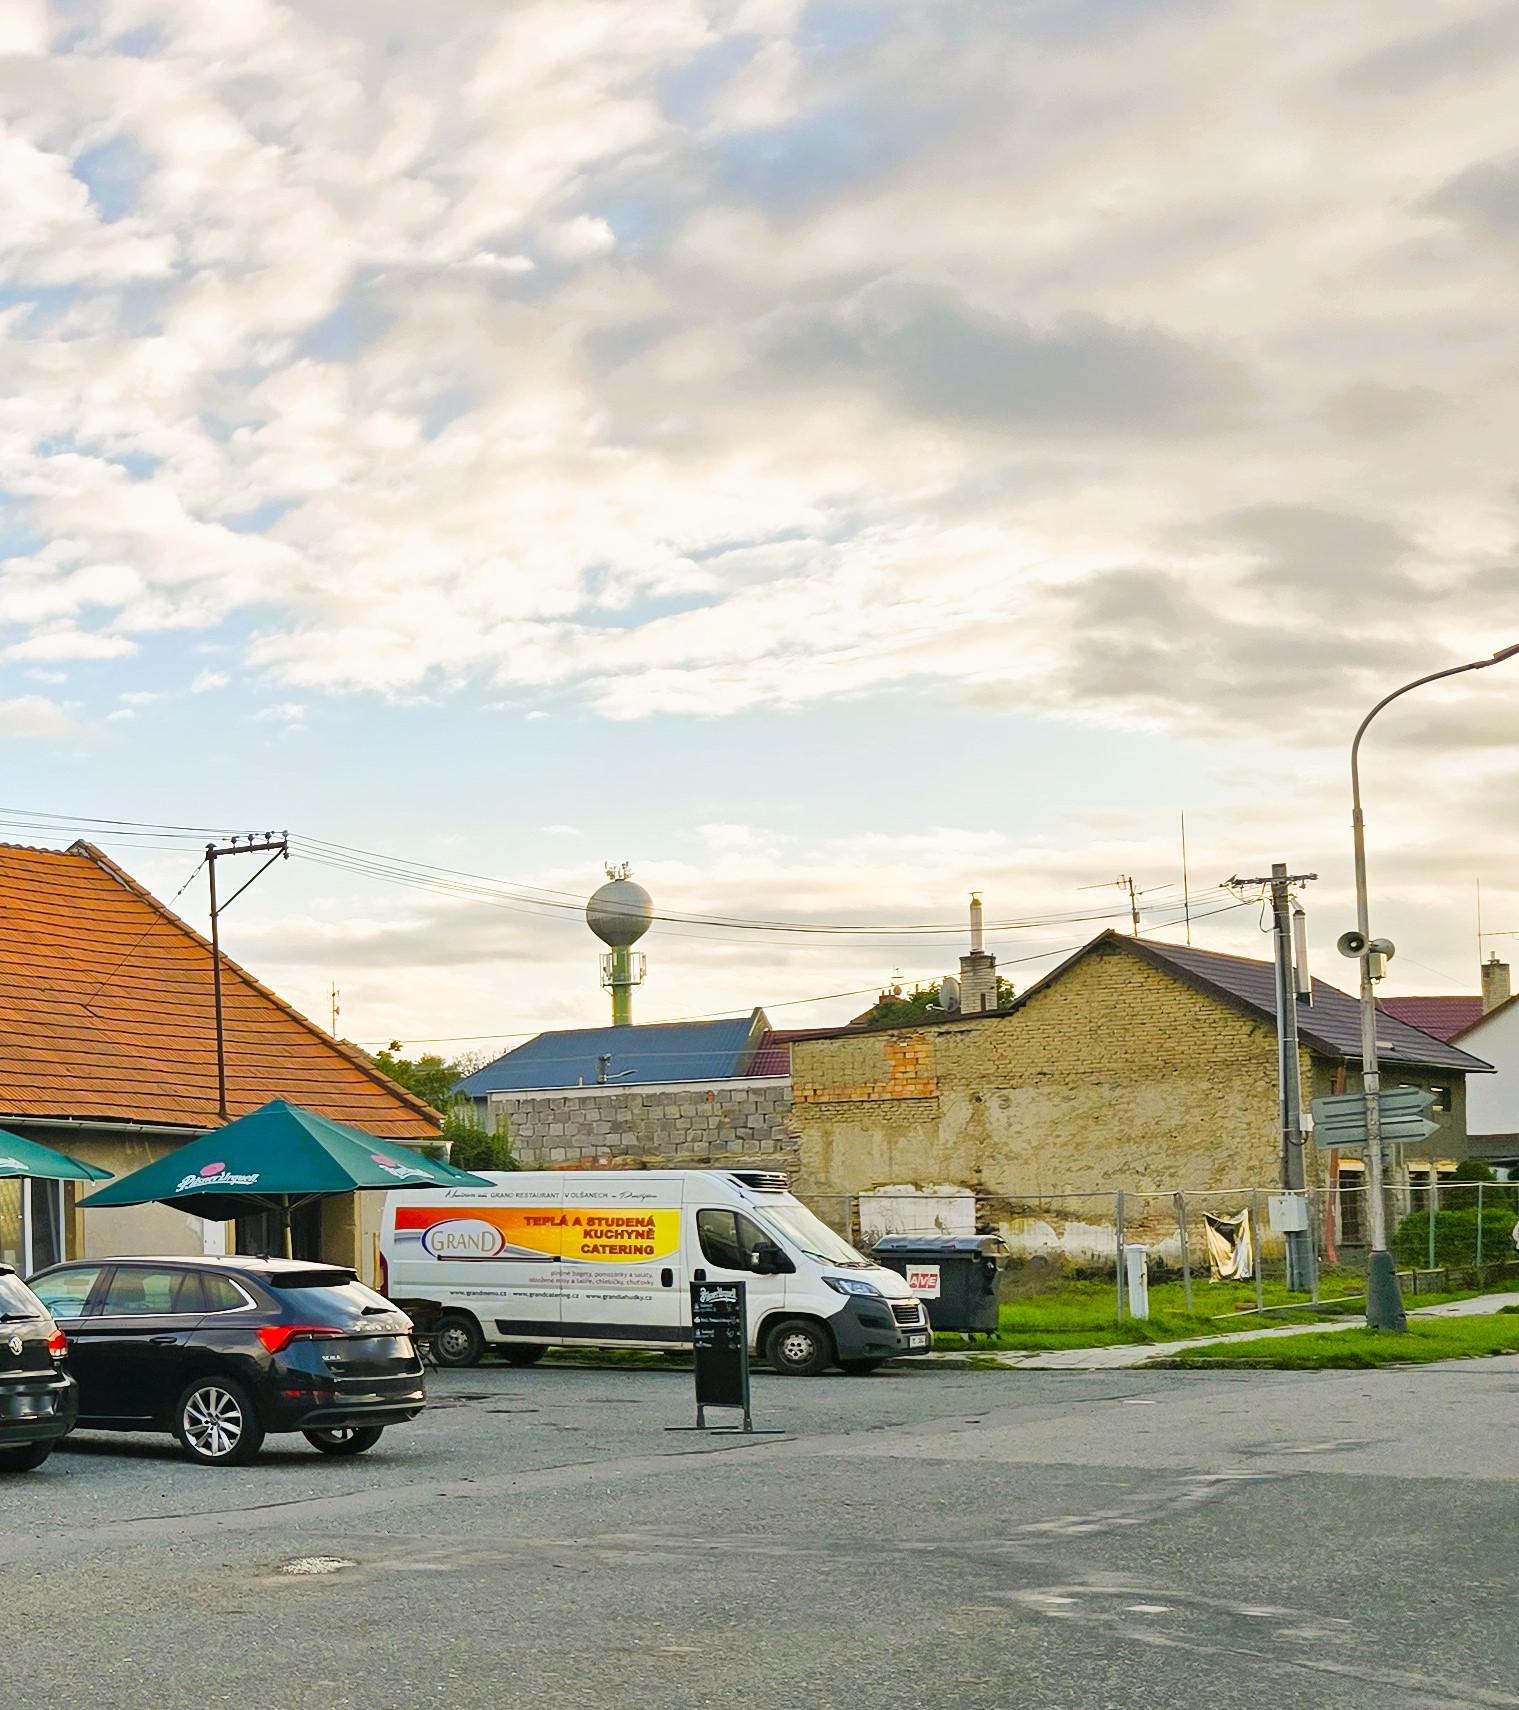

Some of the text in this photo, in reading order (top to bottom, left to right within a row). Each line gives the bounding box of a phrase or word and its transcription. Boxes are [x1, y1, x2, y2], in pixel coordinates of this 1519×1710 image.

[523, 1214, 656, 1228] TEPLÁ A STUDENÁ
[582, 1227, 656, 1240] KUCHYNĚ
[430, 1230, 497, 1253] GRAND
[580, 1243, 655, 1256] CATERING
[909, 1273, 938, 1288] AVE
[512, 1291, 580, 1299] www.grandcatering.cz
